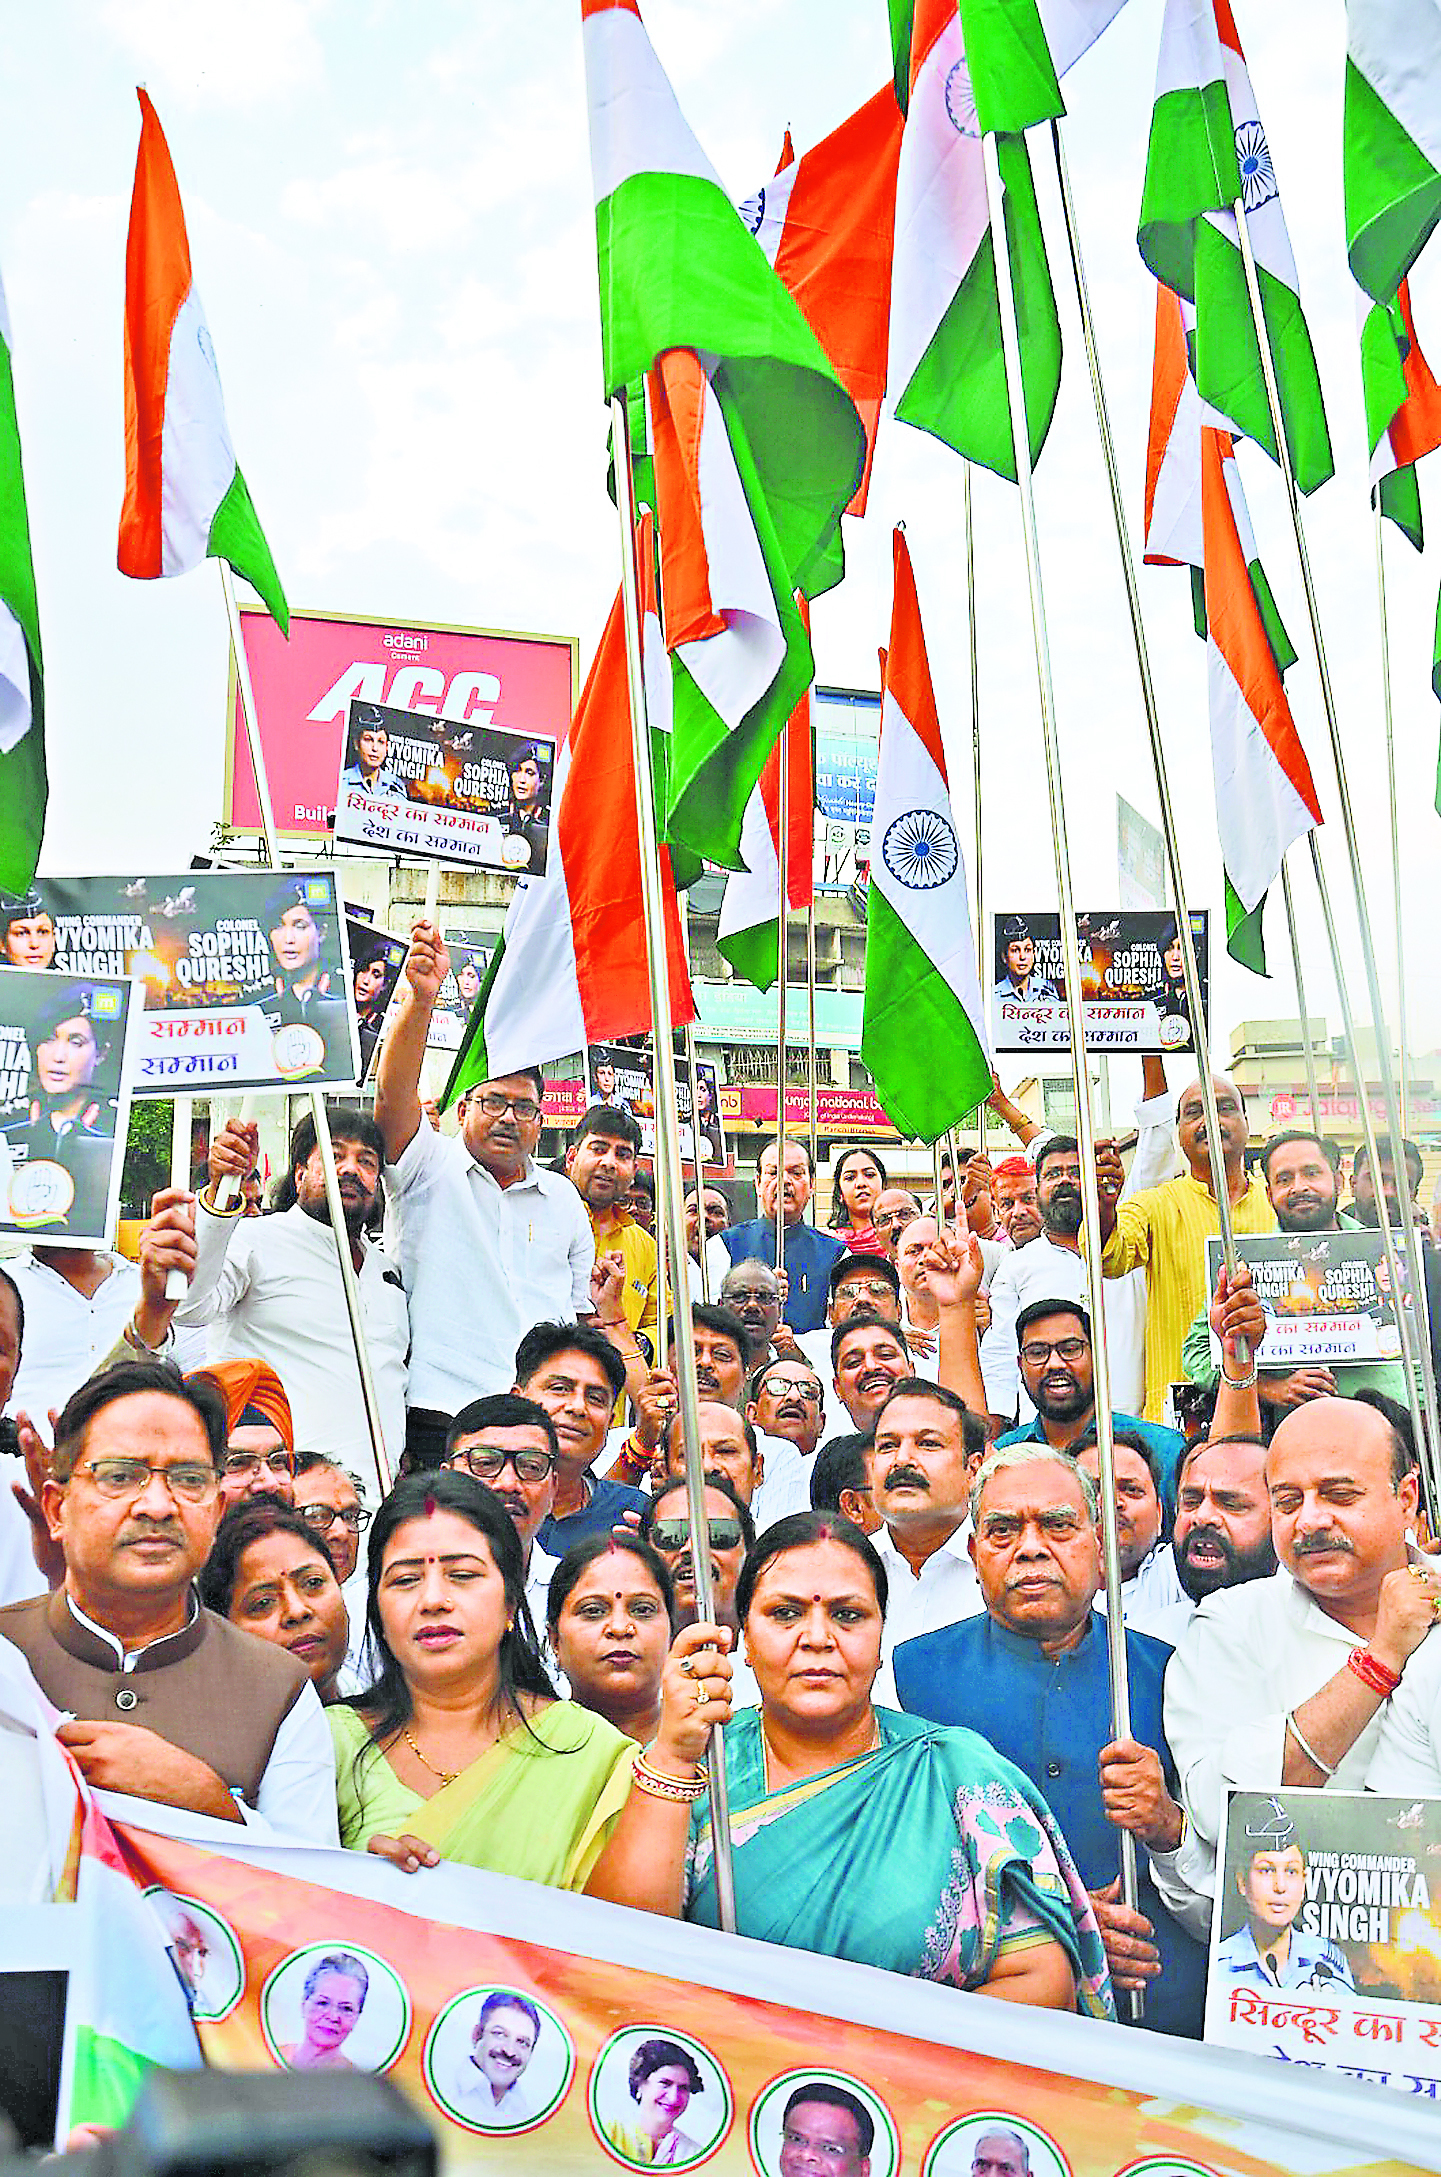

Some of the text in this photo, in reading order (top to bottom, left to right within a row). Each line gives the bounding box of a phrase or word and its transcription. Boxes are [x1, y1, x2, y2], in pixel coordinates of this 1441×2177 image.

[383, 634, 428, 651] adani
[305, 661, 502, 726] ACC
[386, 741, 445, 768] VYOMIKA
[385, 758, 426, 781] SINGH
[463, 763, 510, 787] SOPHIA
[454, 777, 509, 802] QURESHI
[347, 793, 490, 834] सिन्दूर का सम्मान
[362, 819, 482, 856] देश का सम्मान
[216, 919, 260, 932] COLONEL
[54, 926, 154, 950] VYOMIKA
[189, 931, 269, 957] SOPHIA
[54, 951, 125, 975] SINGH
[1113, 951, 1163, 968] SOPHIA
[175, 955, 270, 988] QURESHI
[1033, 963, 1066, 980] SING
[1104, 967, 1163, 988] QURESHI
[1002, 1003, 1054, 1024] सिन्दूर
[1086, 1007, 1146, 1020] सम्मान
[149, 1016, 248, 1037] सम्मान
[1018, 1026, 1047, 1044] देश
[140, 1053, 239, 1075] सम्मान
[820, 1095, 868, 1109] national
[1325, 1268, 1374, 1284] SOPHIA
[1318, 1283, 1376, 1304] QURESHI
[1308, 1851, 1417, 1873] WING COMMANDER
[1305, 1866, 1431, 1909] VYOMIKA
[1302, 1901, 1389, 1943] SINGH
[1228, 1988, 1341, 2045] सिन्दूर
[1353, 2011, 1406, 2043] का
